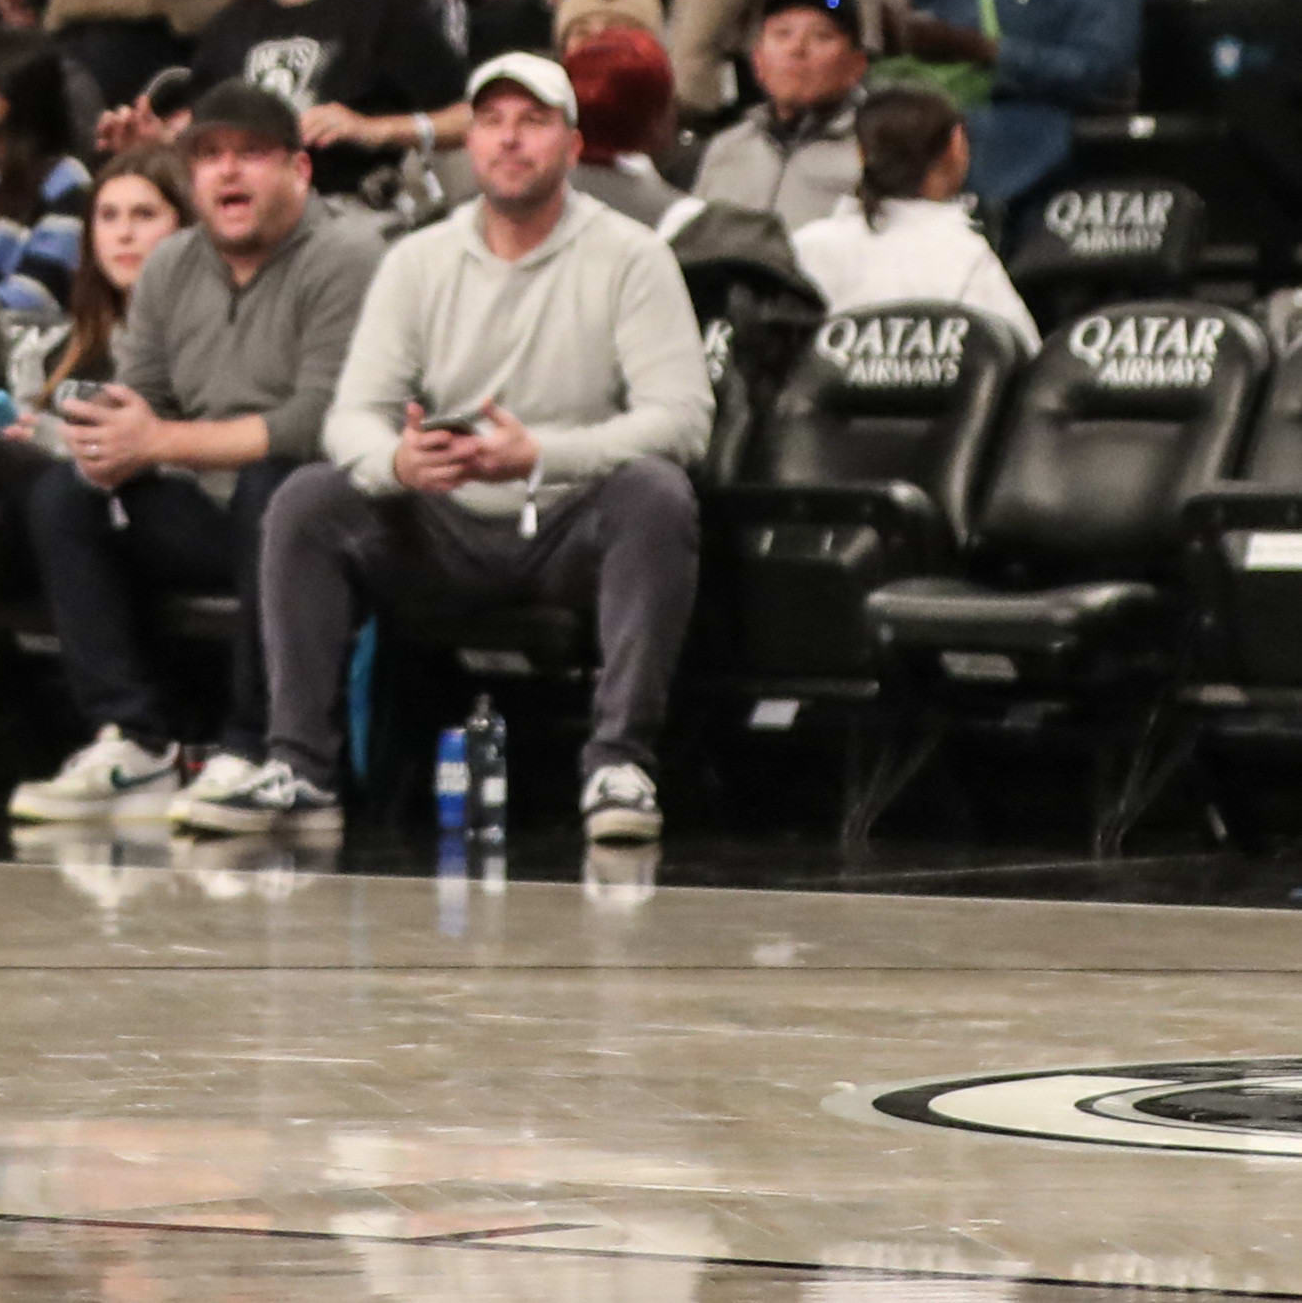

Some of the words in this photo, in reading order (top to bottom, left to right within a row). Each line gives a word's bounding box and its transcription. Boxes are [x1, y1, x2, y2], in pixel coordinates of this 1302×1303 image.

[1045, 190, 1174, 238] QATAR
[815, 316, 970, 368] QATAR
[1068, 315, 1225, 366] QATAR
[848, 357, 960, 384] AIRWAYS
[1097, 356, 1213, 386] AIRWAYS
